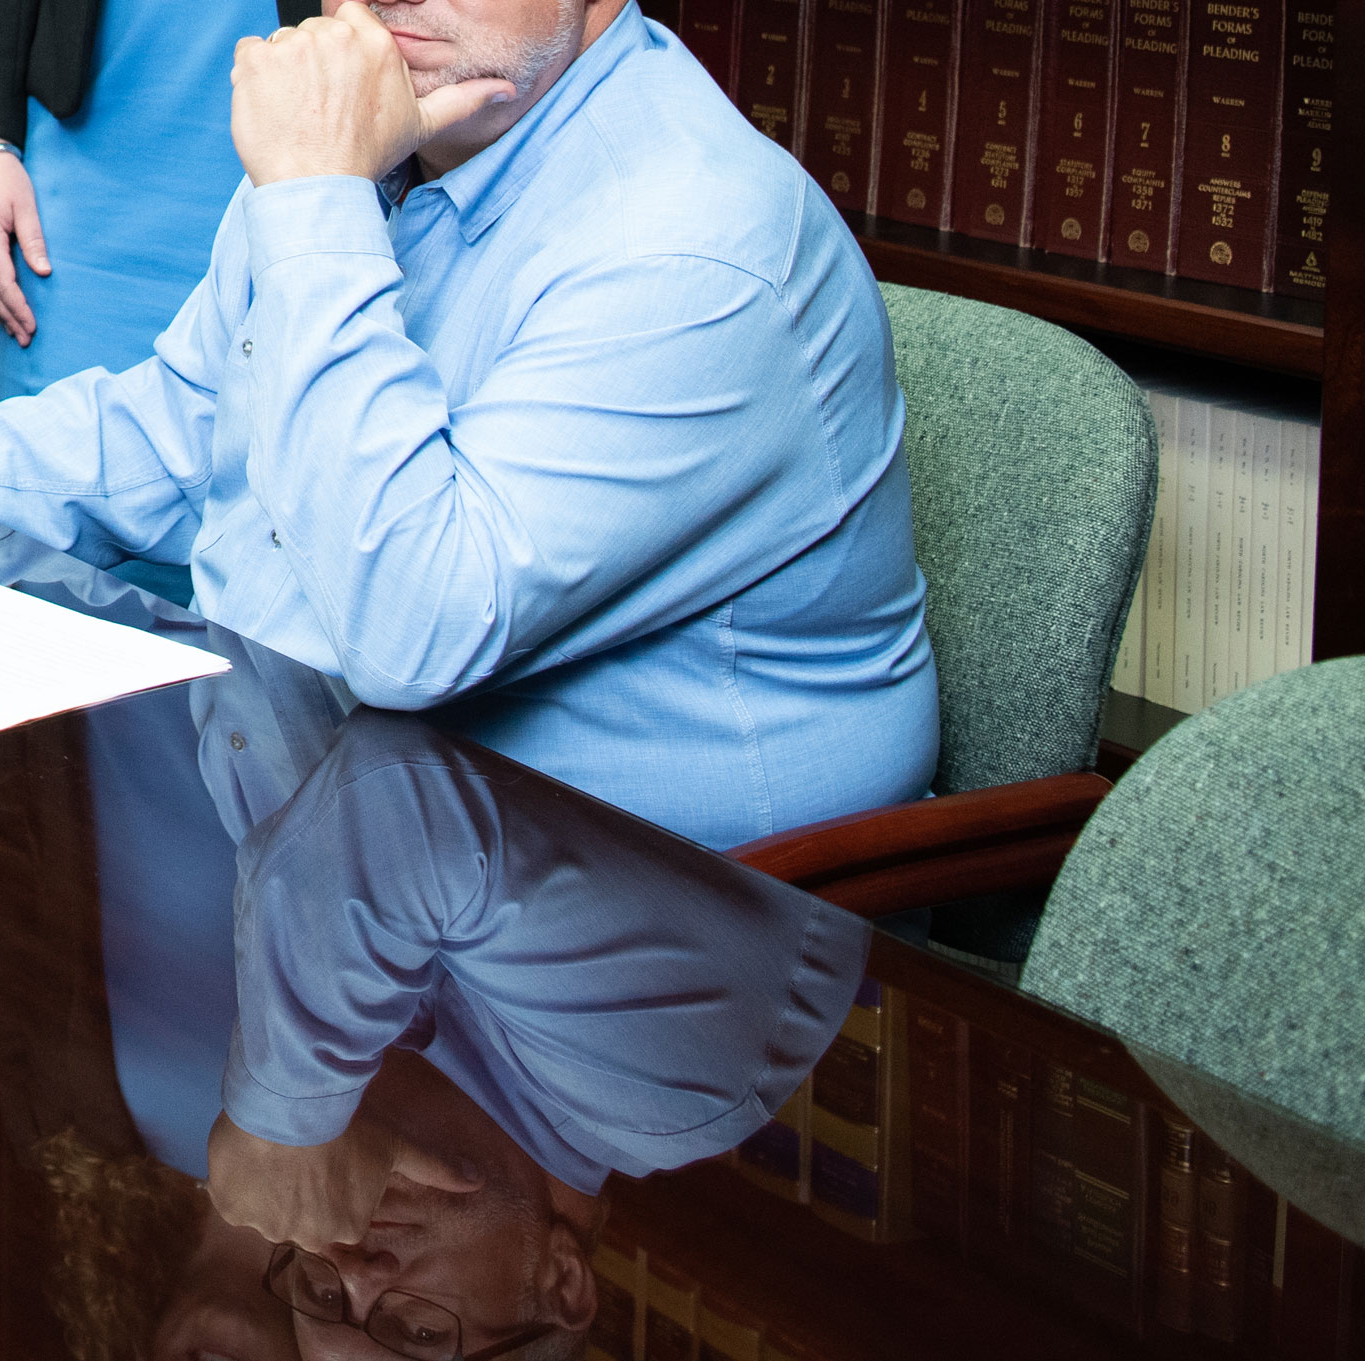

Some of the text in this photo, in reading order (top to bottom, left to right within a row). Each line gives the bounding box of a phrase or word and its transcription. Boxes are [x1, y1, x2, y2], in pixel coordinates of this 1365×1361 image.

[1069, 5, 1105, 21] FORMS
[1133, 12, 1173, 28] FORMS
[1207, 2, 1260, 20] BENDER'S
[985, 19, 1033, 37] PLEADING
[1212, 20, 1253, 35] FORMS
[1061, 28, 1110, 47] PLEADING
[1125, 37, 1179, 55] PLEADING
[1203, 44, 1260, 63] PLEADING
[1133, 87, 1165, 99] WARREN
[1212, 96, 1246, 107] WARREN
[998, 100, 1008, 119] 5
[1073, 112, 1083, 131] 6
[1140, 121, 1151, 140] 7
[1221, 134, 1231, 154] 8
[1311, 147, 1323, 167] 9
